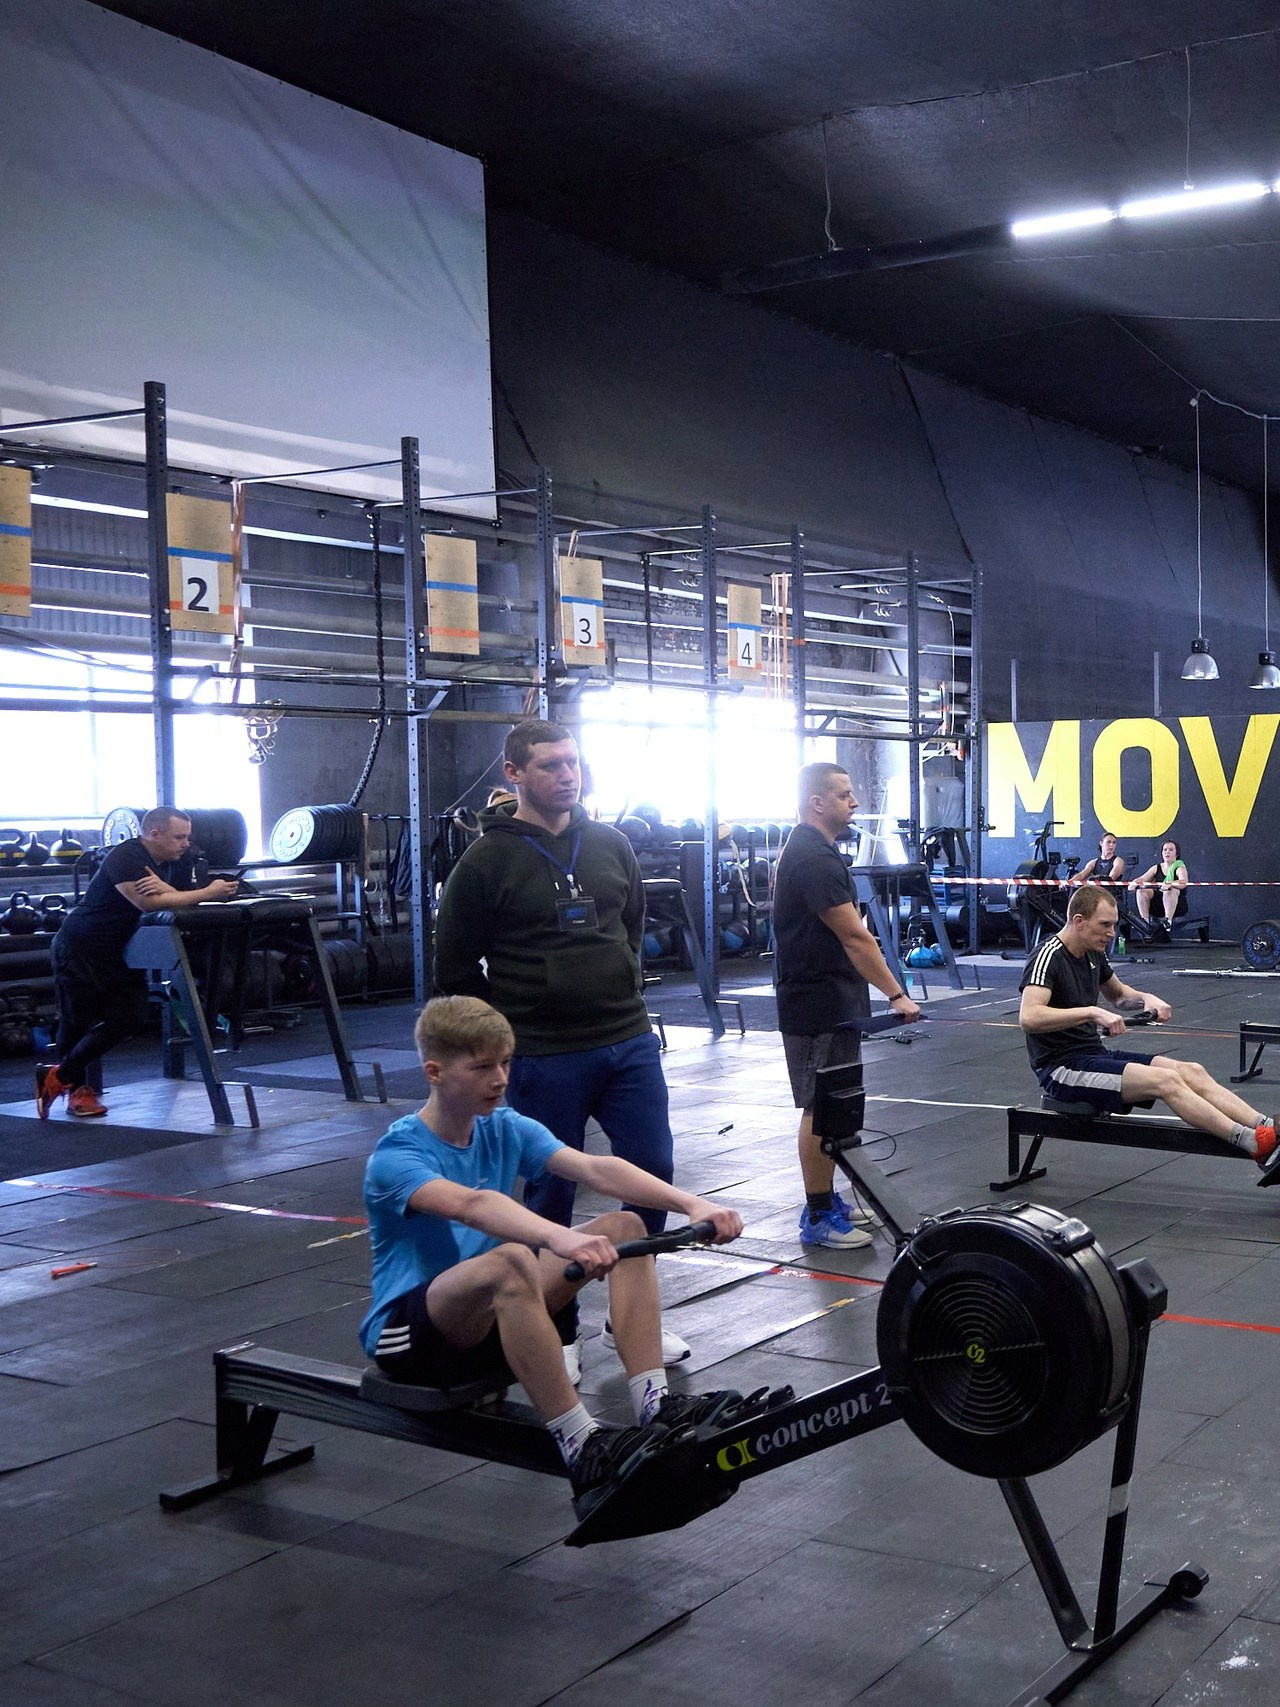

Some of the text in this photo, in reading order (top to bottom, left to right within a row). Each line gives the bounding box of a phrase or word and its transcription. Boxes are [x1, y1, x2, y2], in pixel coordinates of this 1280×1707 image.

[187, 577, 210, 612] 2
[578, 618, 592, 645] 3
[741, 642, 753, 665] 4
[755, 1392, 873, 1454] concept
[875, 1383, 893, 1406] 2
